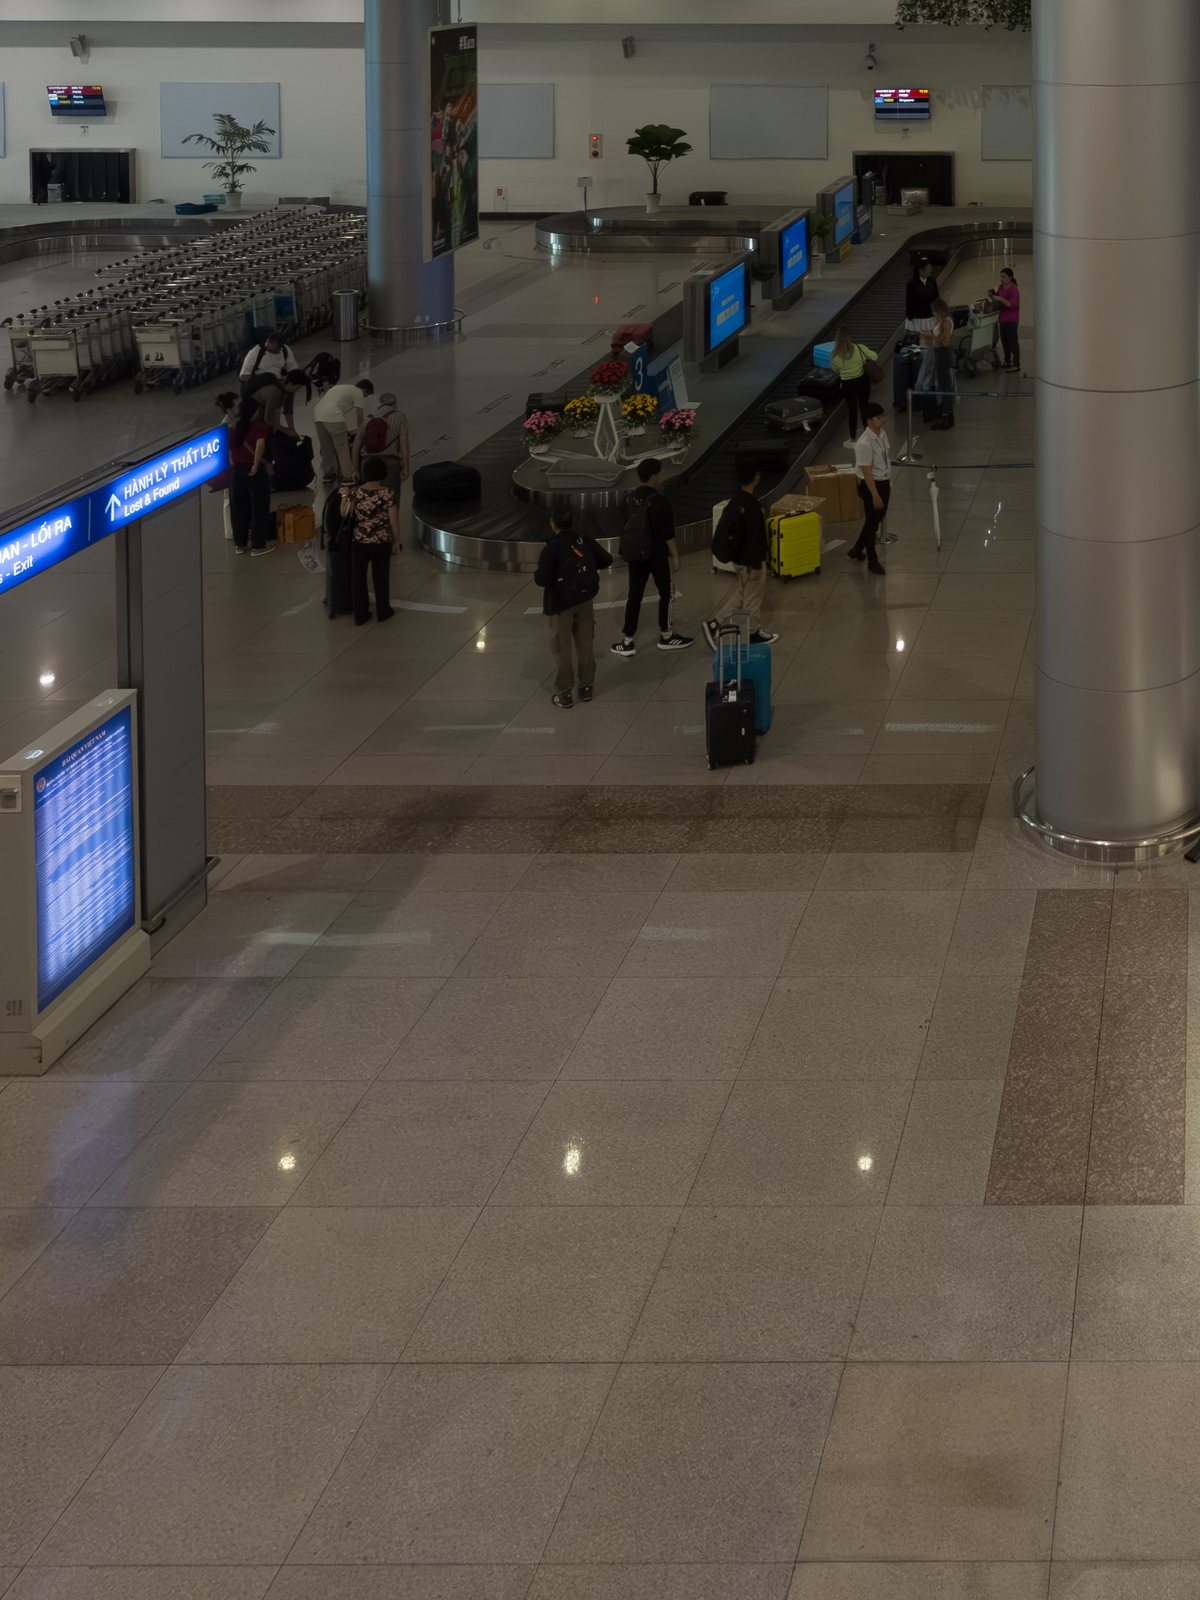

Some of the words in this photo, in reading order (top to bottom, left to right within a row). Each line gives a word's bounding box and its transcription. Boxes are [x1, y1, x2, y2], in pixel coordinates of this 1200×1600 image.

[634, 356, 643, 391] 3
[123, 473, 154, 500] HÀNH
[156, 462, 168, 482] LÝ
[170, 448, 198, 474] THẤT
[201, 438, 220, 462] LẠC
[124, 499, 143, 518] Lost
[144, 494, 151, 506] &
[153, 478, 180, 502] Found
[31, 521, 52, 548] LỐI
[54, 516, 72, 536] RA
[14, 555, 34, 576] Exit
